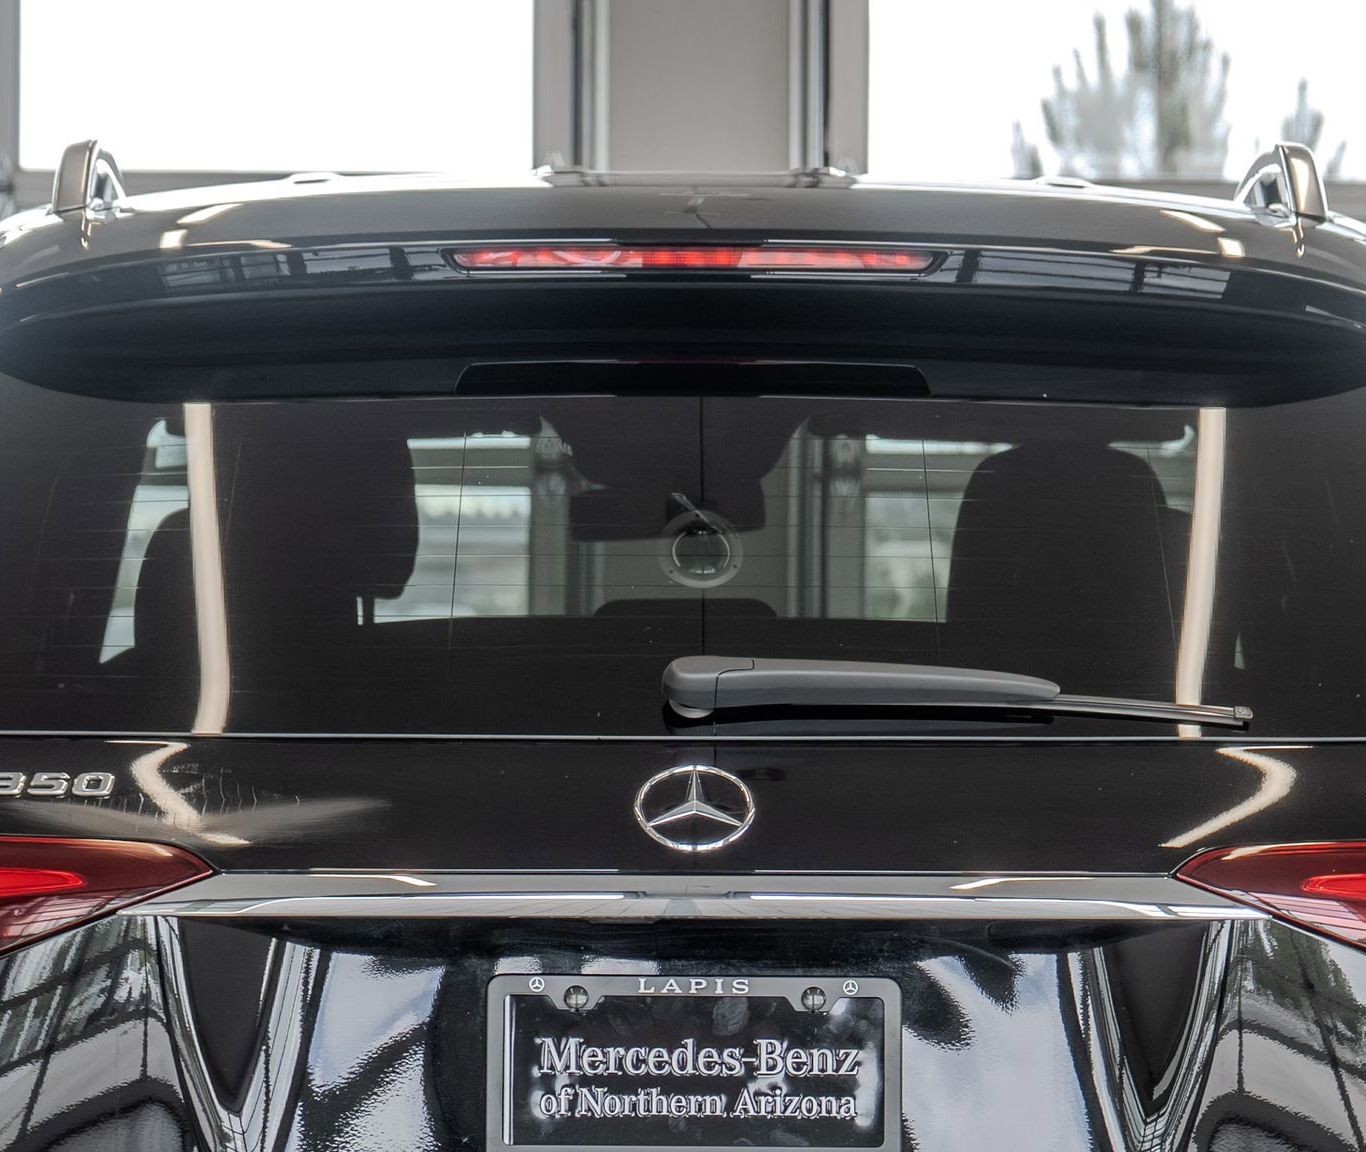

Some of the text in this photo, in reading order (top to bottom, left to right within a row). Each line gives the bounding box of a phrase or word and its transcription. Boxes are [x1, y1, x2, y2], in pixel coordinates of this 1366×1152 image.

[637, 977, 751, 995] LAPIS
[539, 1037, 859, 1077] Mercedes-Benz
[539, 1085, 857, 1119] of Northern Arizona
